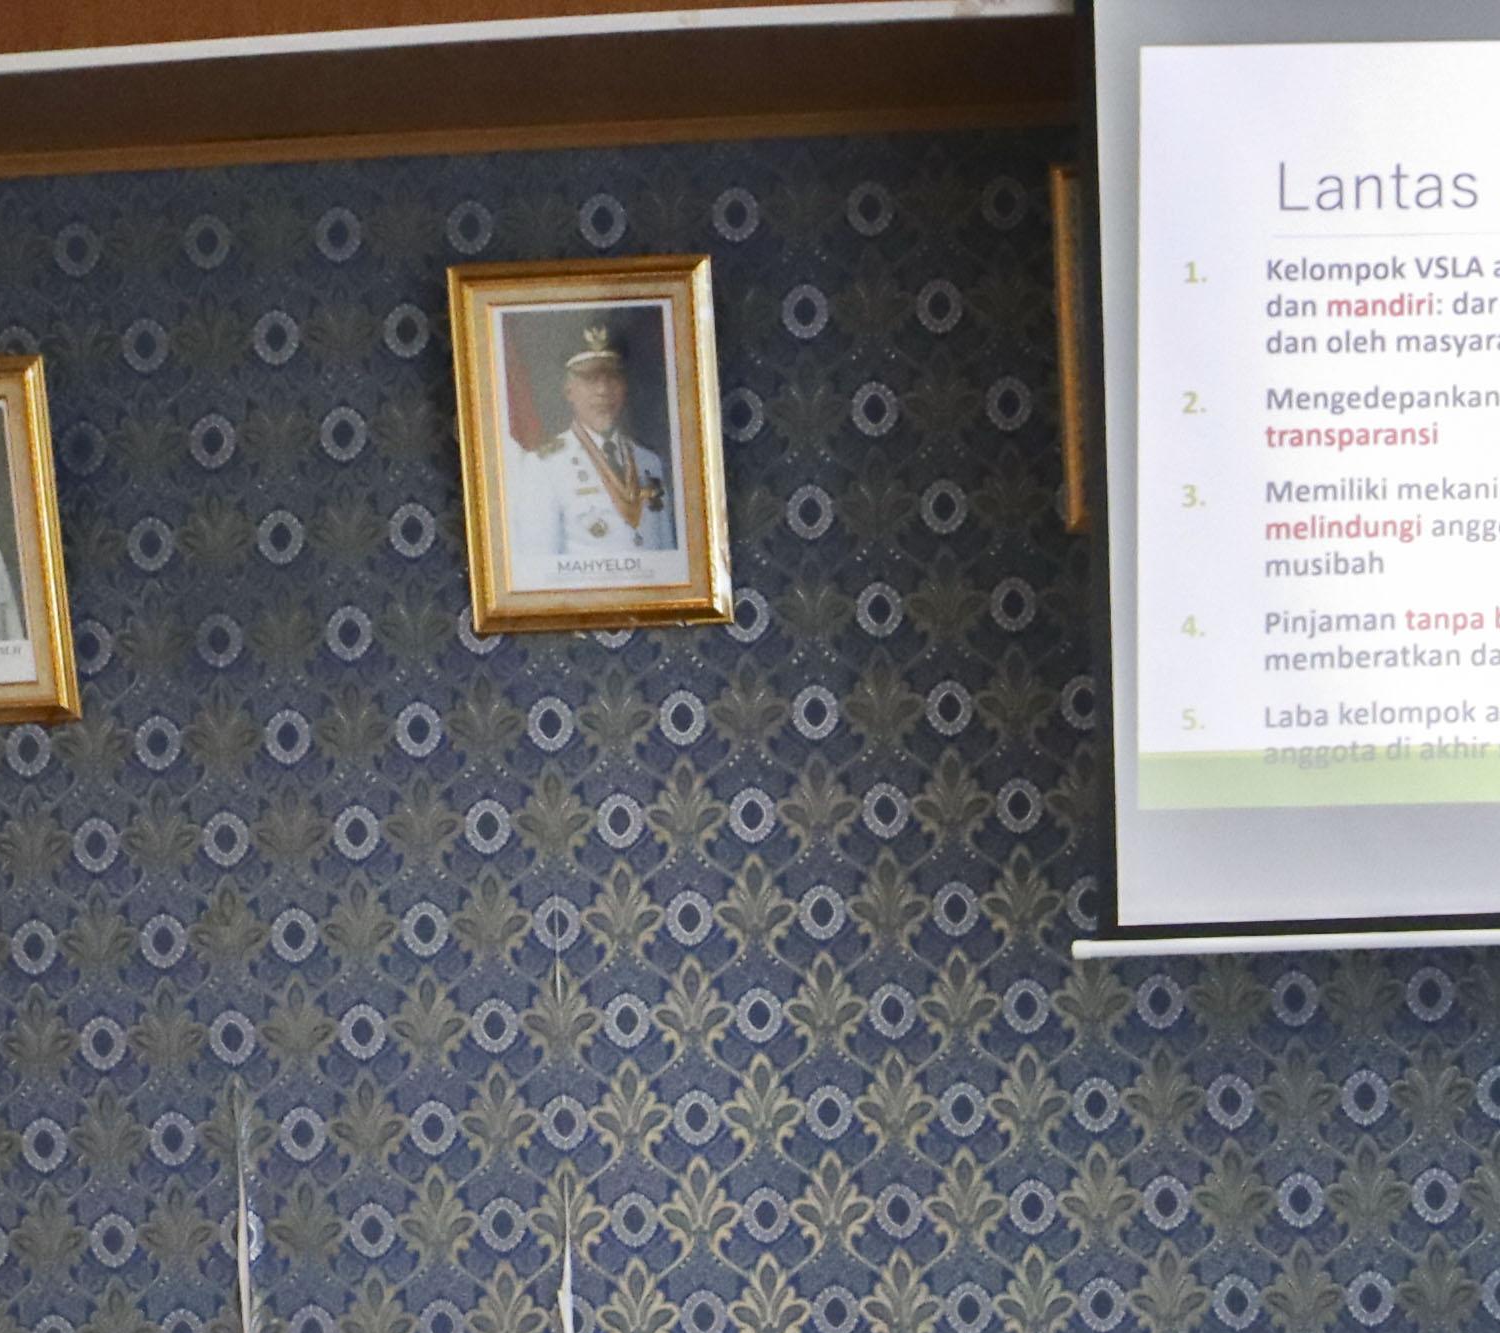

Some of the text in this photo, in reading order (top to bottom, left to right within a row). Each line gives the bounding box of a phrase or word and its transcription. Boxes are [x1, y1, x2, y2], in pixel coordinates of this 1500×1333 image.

[1279, 162, 1478, 212] Lantas
[1185, 261, 1206, 284] 1.
[1267, 256, 1405, 286] Kelompok
[1414, 256, 1484, 279] VSLA
[1266, 294, 1317, 318] dan
[1327, 293, 1442, 318] mandiri:
[1266, 330, 1317, 354] dan
[1326, 329, 1386, 354] oleh
[1183, 391, 1206, 414] 2.
[1266, 385, 1500, 415] Mengedepankan
[1265, 422, 1438, 452] transparansi
[1182, 484, 1205, 508] 3.
[1266, 477, 1387, 503] Memiliki
[1265, 514, 1422, 543] melindungi
[557, 558, 642, 573] MAHYELDI
[1265, 550, 1384, 577] musibah
[1181, 615, 1204, 637] 4.
[1265, 609, 1395, 639] Pinjaman
[1405, 610, 1484, 635] tanpa
[1264, 644, 1460, 671] memberatkan
[1182, 708, 1205, 731] 5.
[1265, 703, 1329, 729] Laba
[1338, 700, 1475, 729] kelompok
[1263, 740, 1377, 768] anggota
[1385, 737, 1411, 761] di
[1418, 736, 1488, 760] akhir
